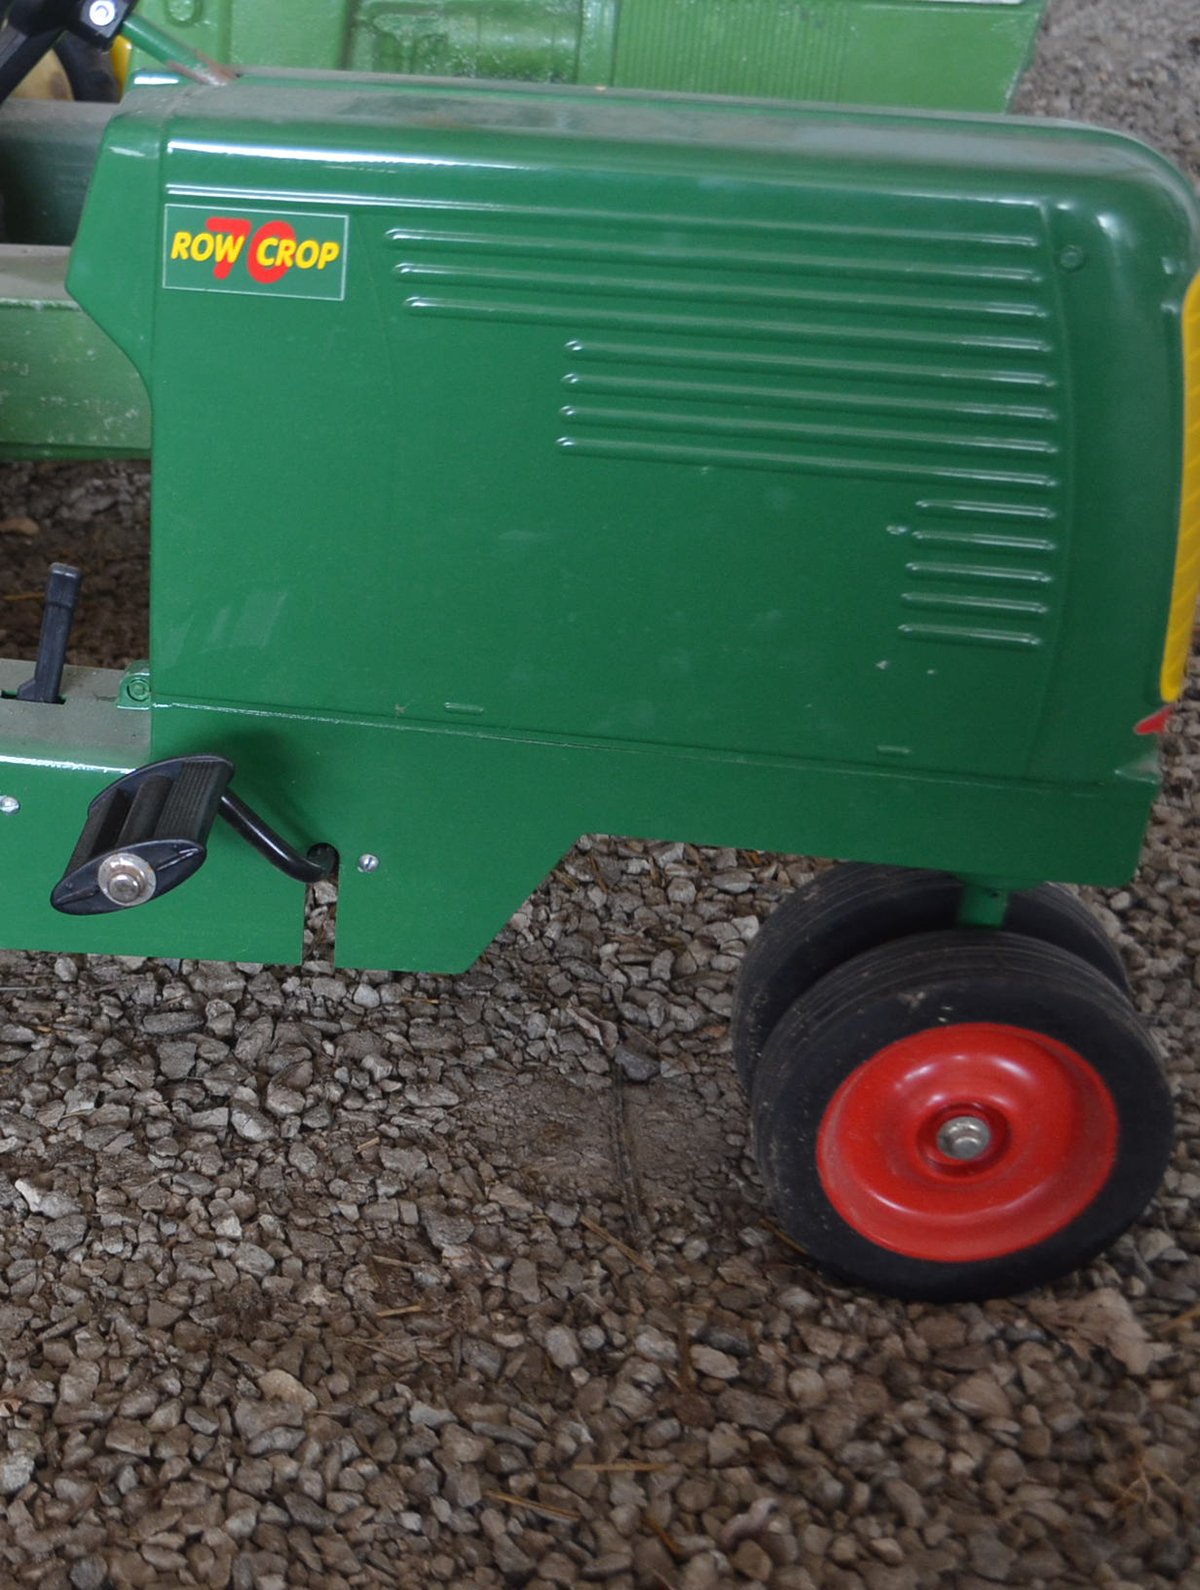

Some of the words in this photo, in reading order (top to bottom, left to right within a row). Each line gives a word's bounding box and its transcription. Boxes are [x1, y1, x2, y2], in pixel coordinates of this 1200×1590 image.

[170, 231, 244, 263] ROW
[256, 237, 340, 270] CROP
[205, 216, 297, 284] 70
